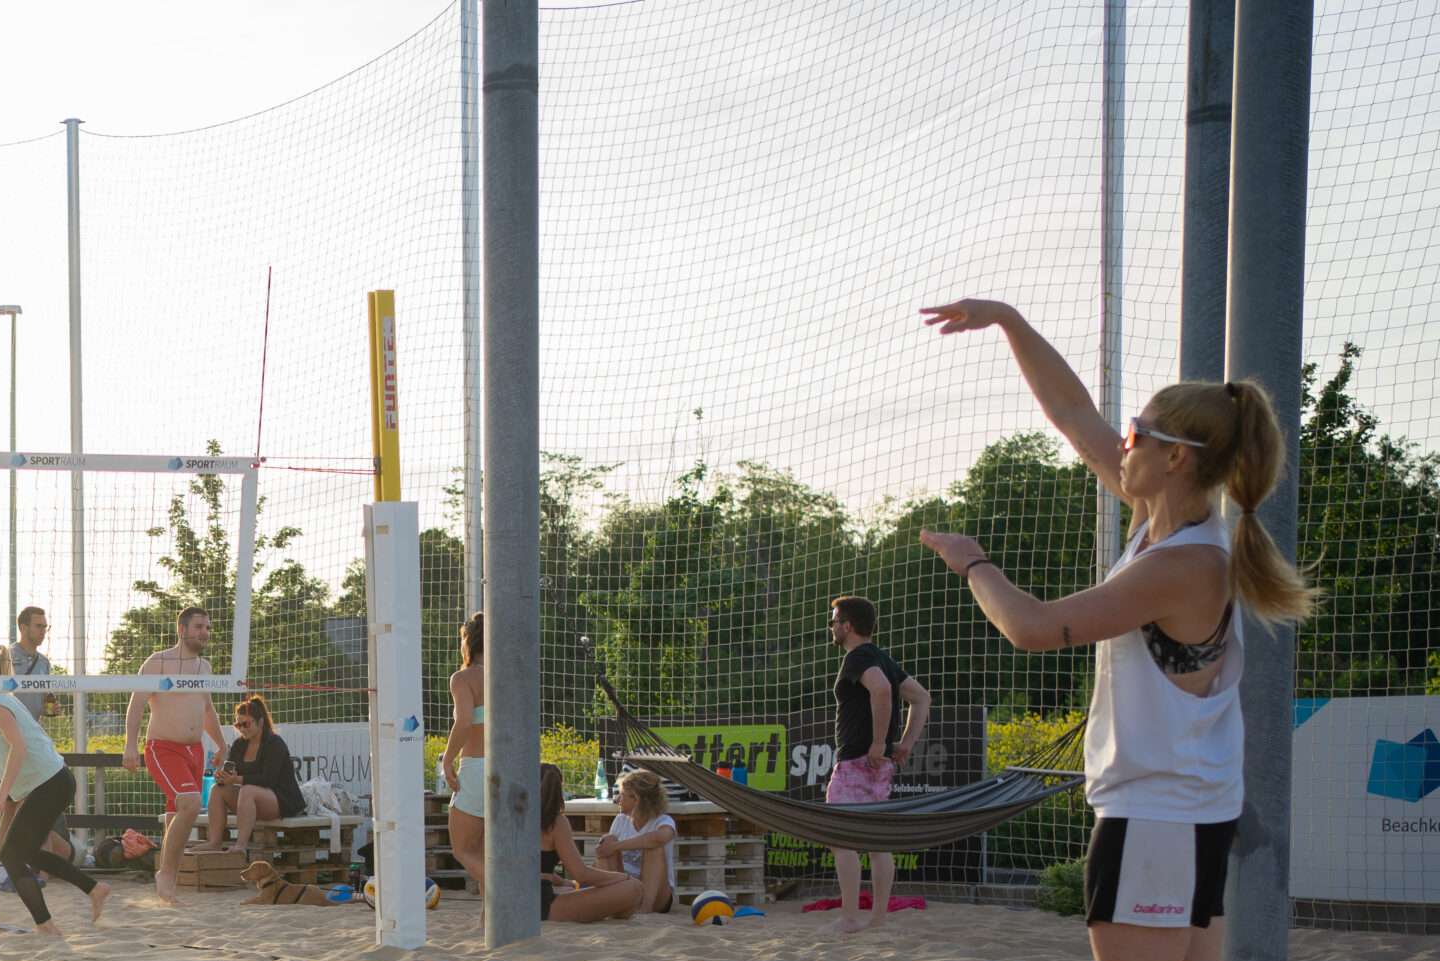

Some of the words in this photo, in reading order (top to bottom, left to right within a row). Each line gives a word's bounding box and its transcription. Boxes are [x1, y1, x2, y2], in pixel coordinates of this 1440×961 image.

[30, 456, 86, 467] SPORTRAUM
[185, 459, 239, 470] SPORTRAUM
[21, 680, 77, 691] SPORTRAUM
[175, 679, 229, 690] SPORTRAUM
[768, 850, 809, 866] TENNIS
